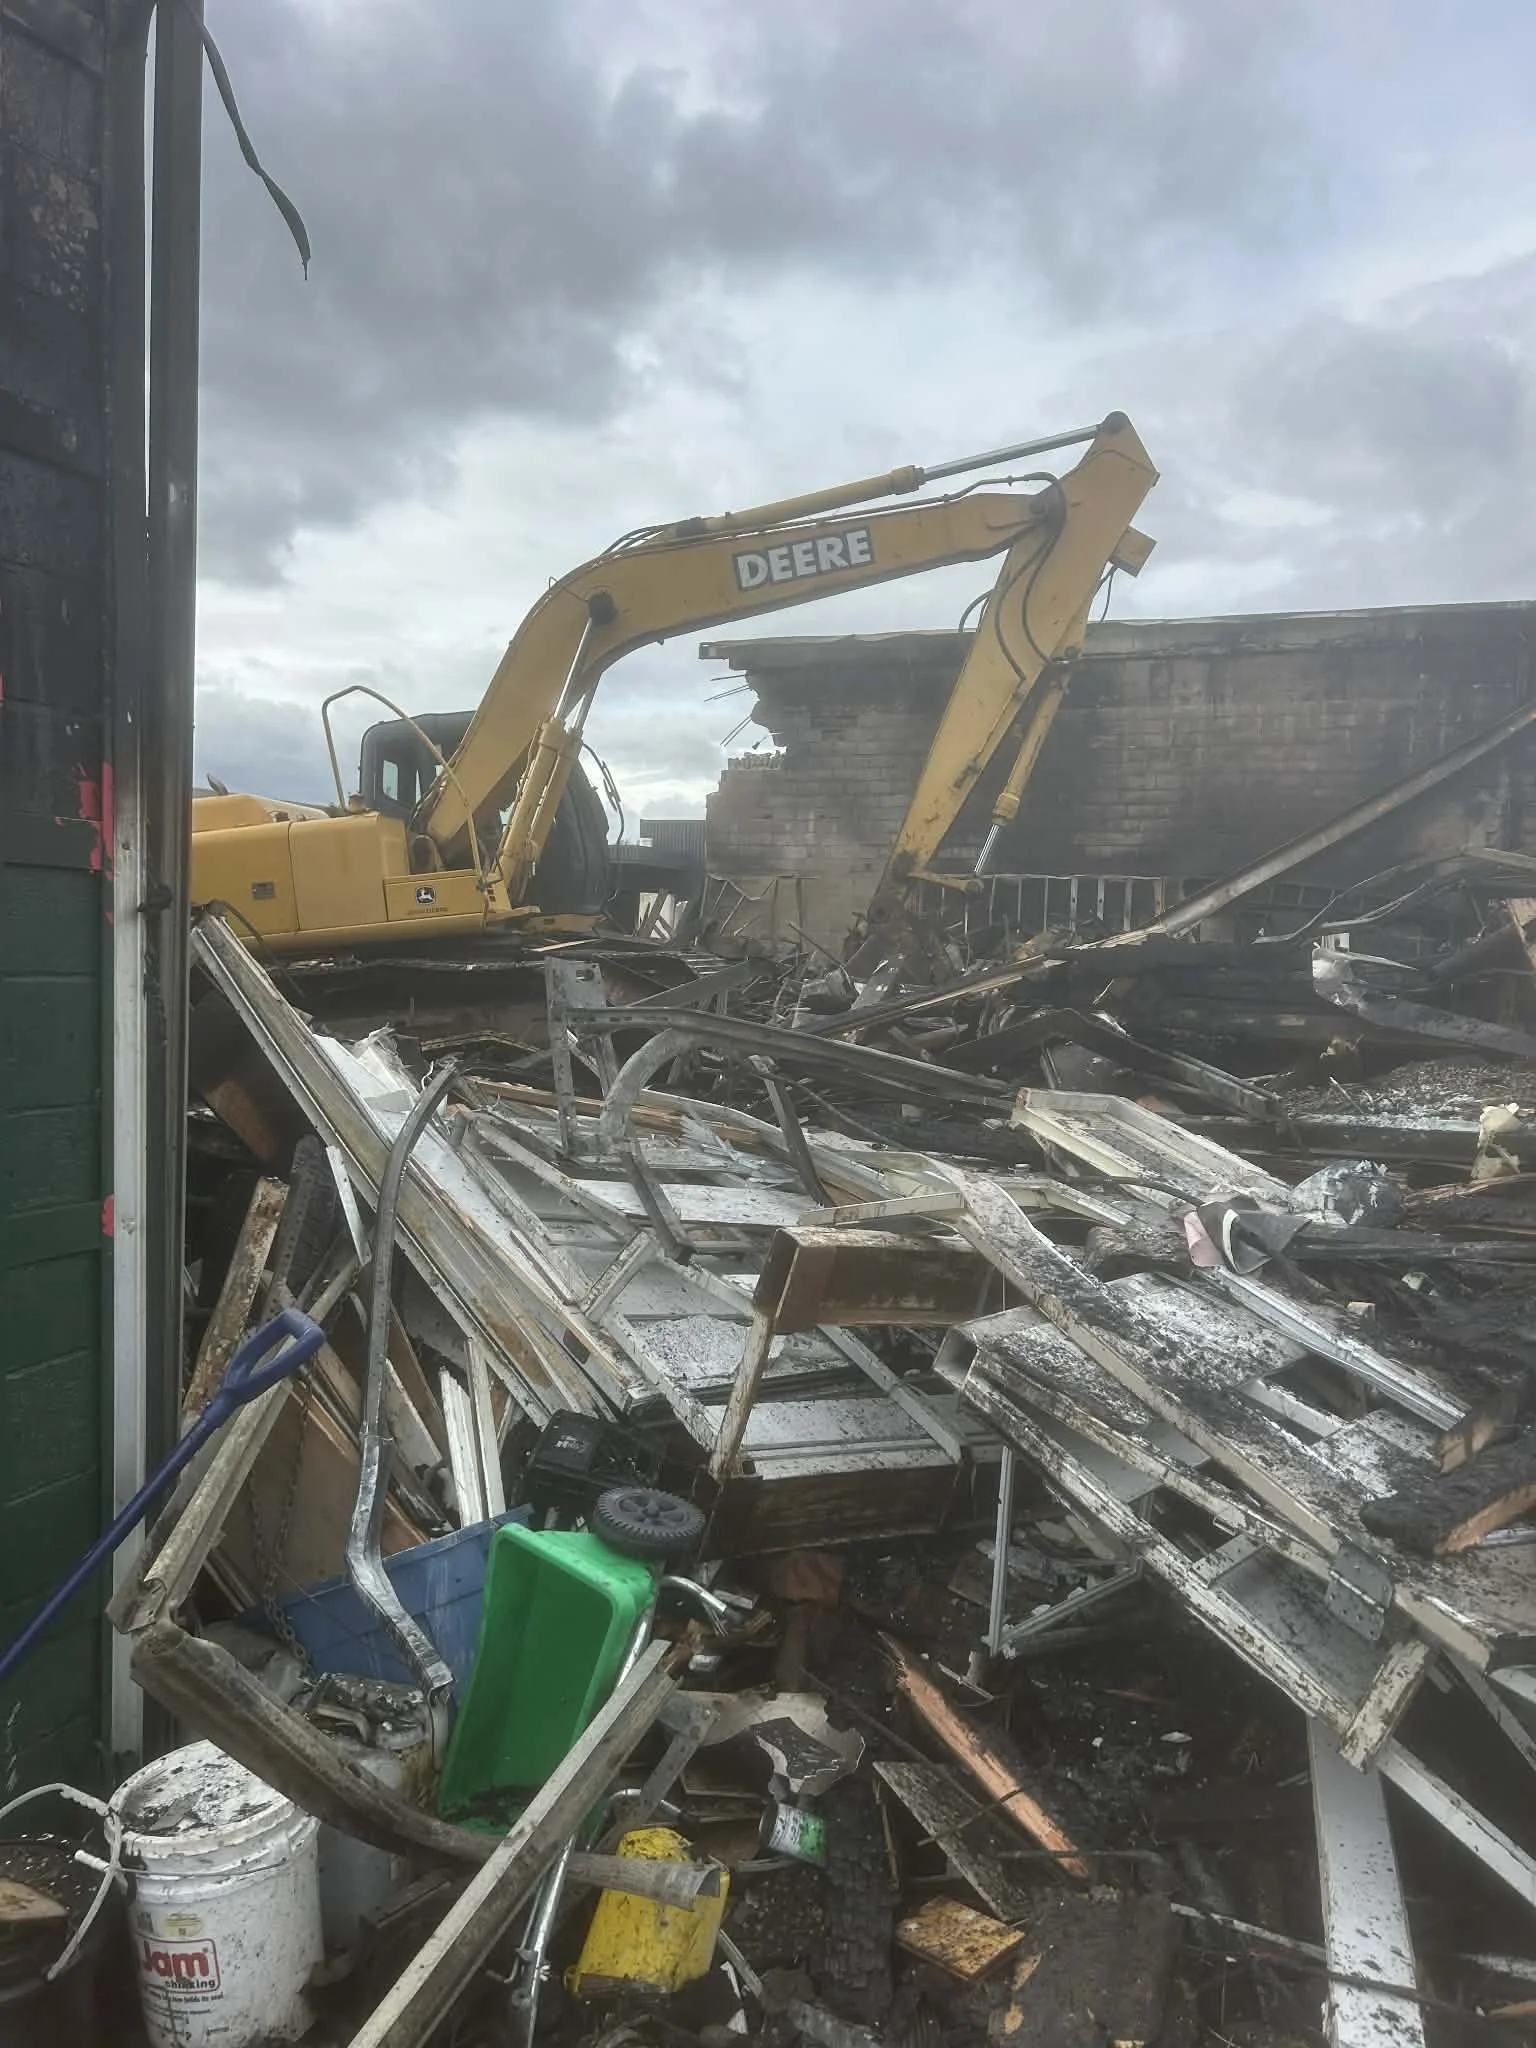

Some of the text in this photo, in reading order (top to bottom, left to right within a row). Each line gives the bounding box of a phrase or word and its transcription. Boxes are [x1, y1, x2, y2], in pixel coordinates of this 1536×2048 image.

[736, 528, 872, 589] DEERE
[142, 1940, 210, 1978] Jam
[165, 1979, 216, 1990] shrking
